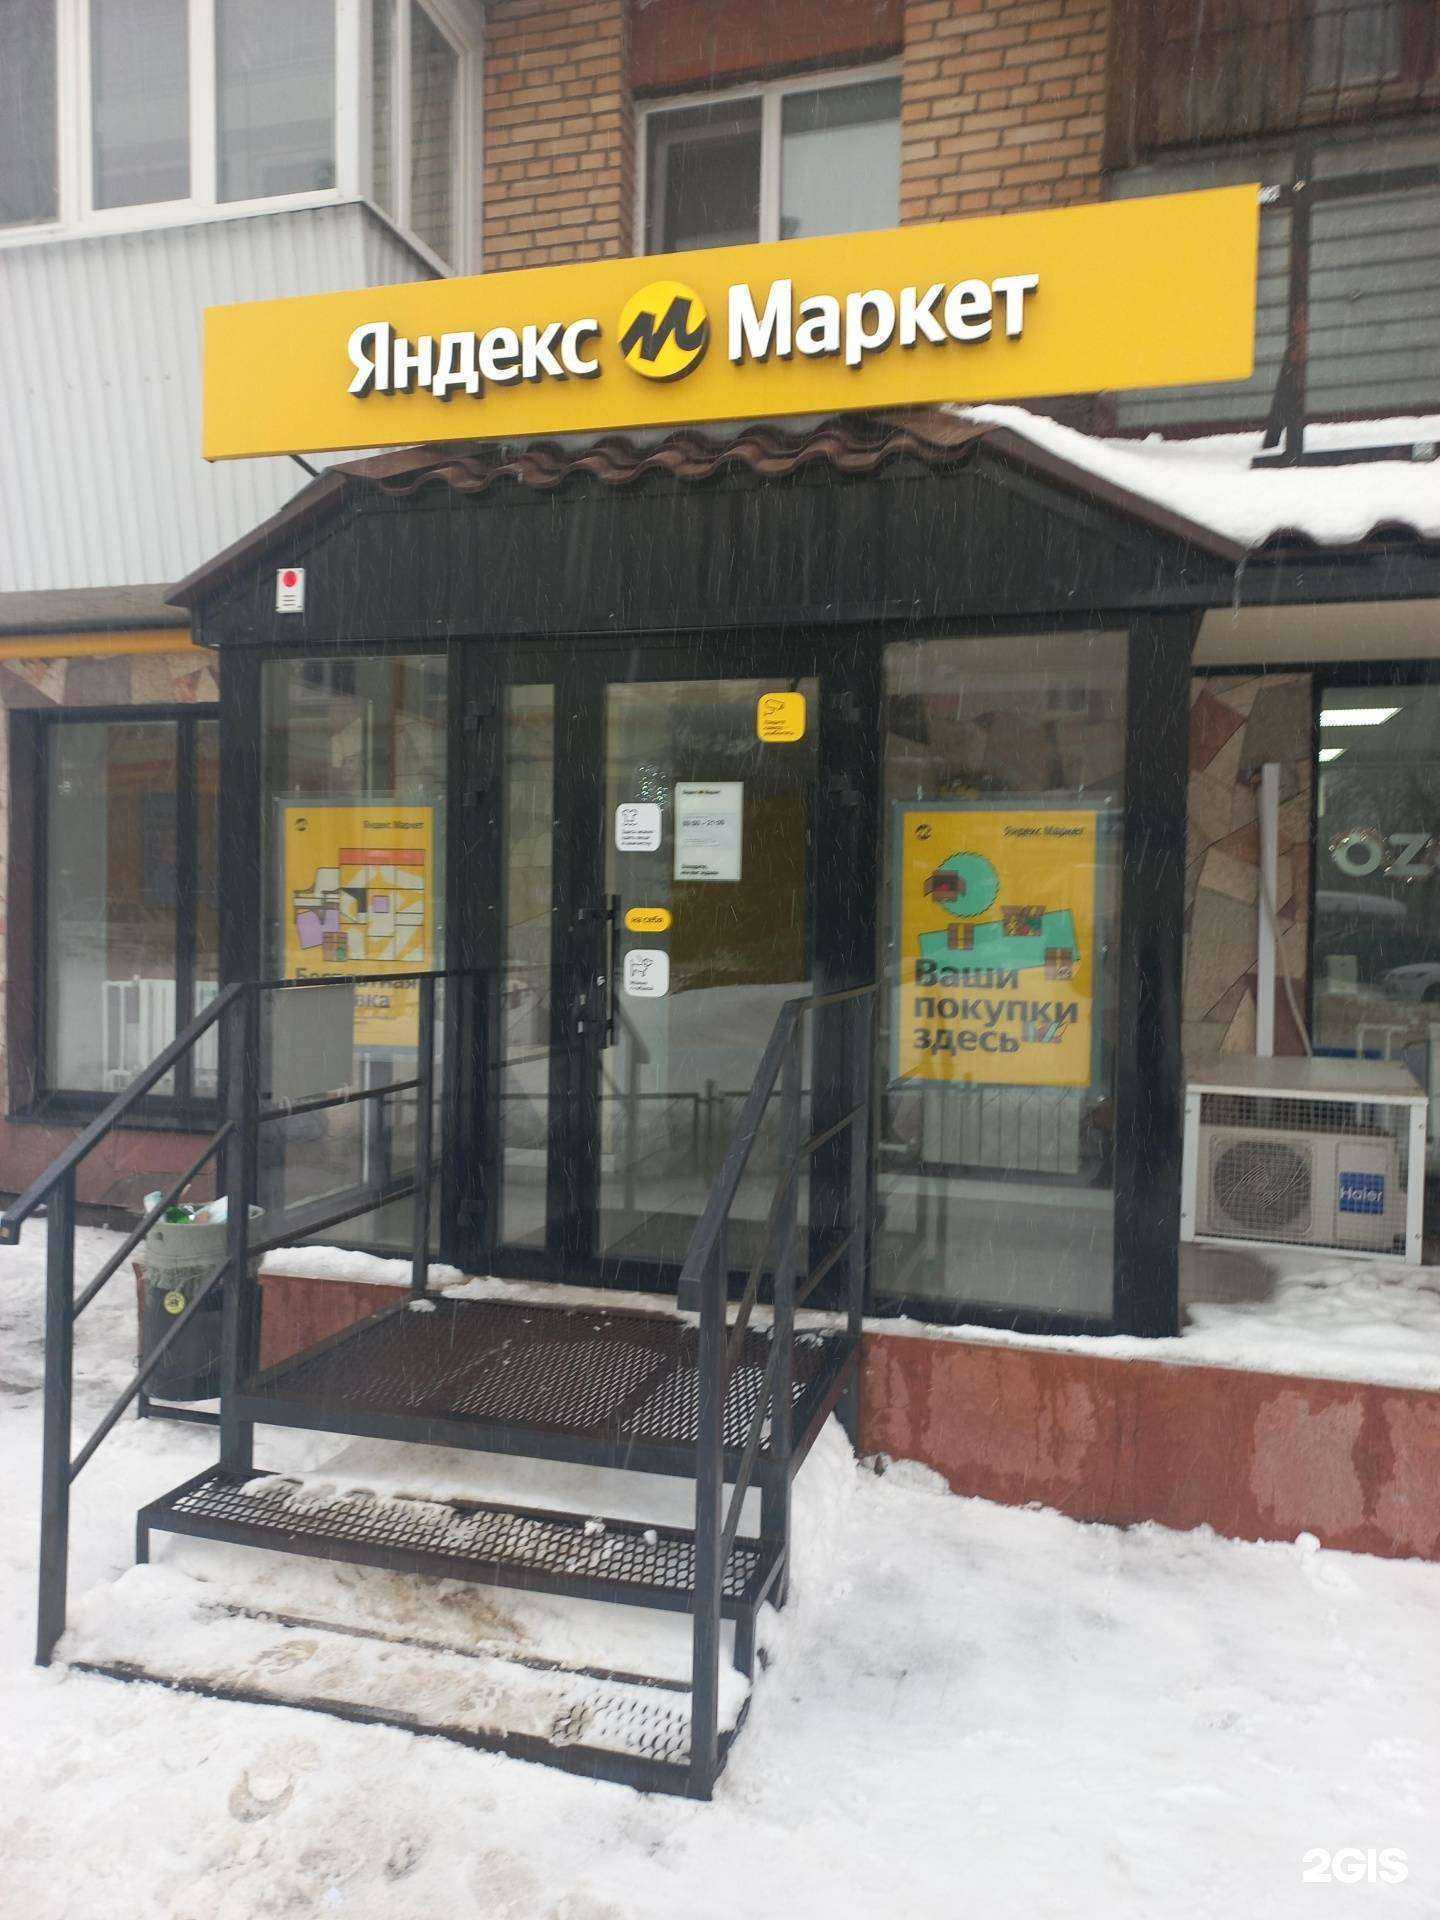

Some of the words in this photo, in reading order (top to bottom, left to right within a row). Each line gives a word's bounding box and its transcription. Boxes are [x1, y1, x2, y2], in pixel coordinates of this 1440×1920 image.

[348, 317, 600, 401] Яндекс
[728, 273, 1040, 369] Маркет
[1334, 827, 1440, 877] OZ
[914, 957, 1020, 990] Ваши
[914, 997, 1079, 1028] покупки
[912, 1028, 1021, 1056] здесь
[1339, 1186, 1384, 1201] Haier
